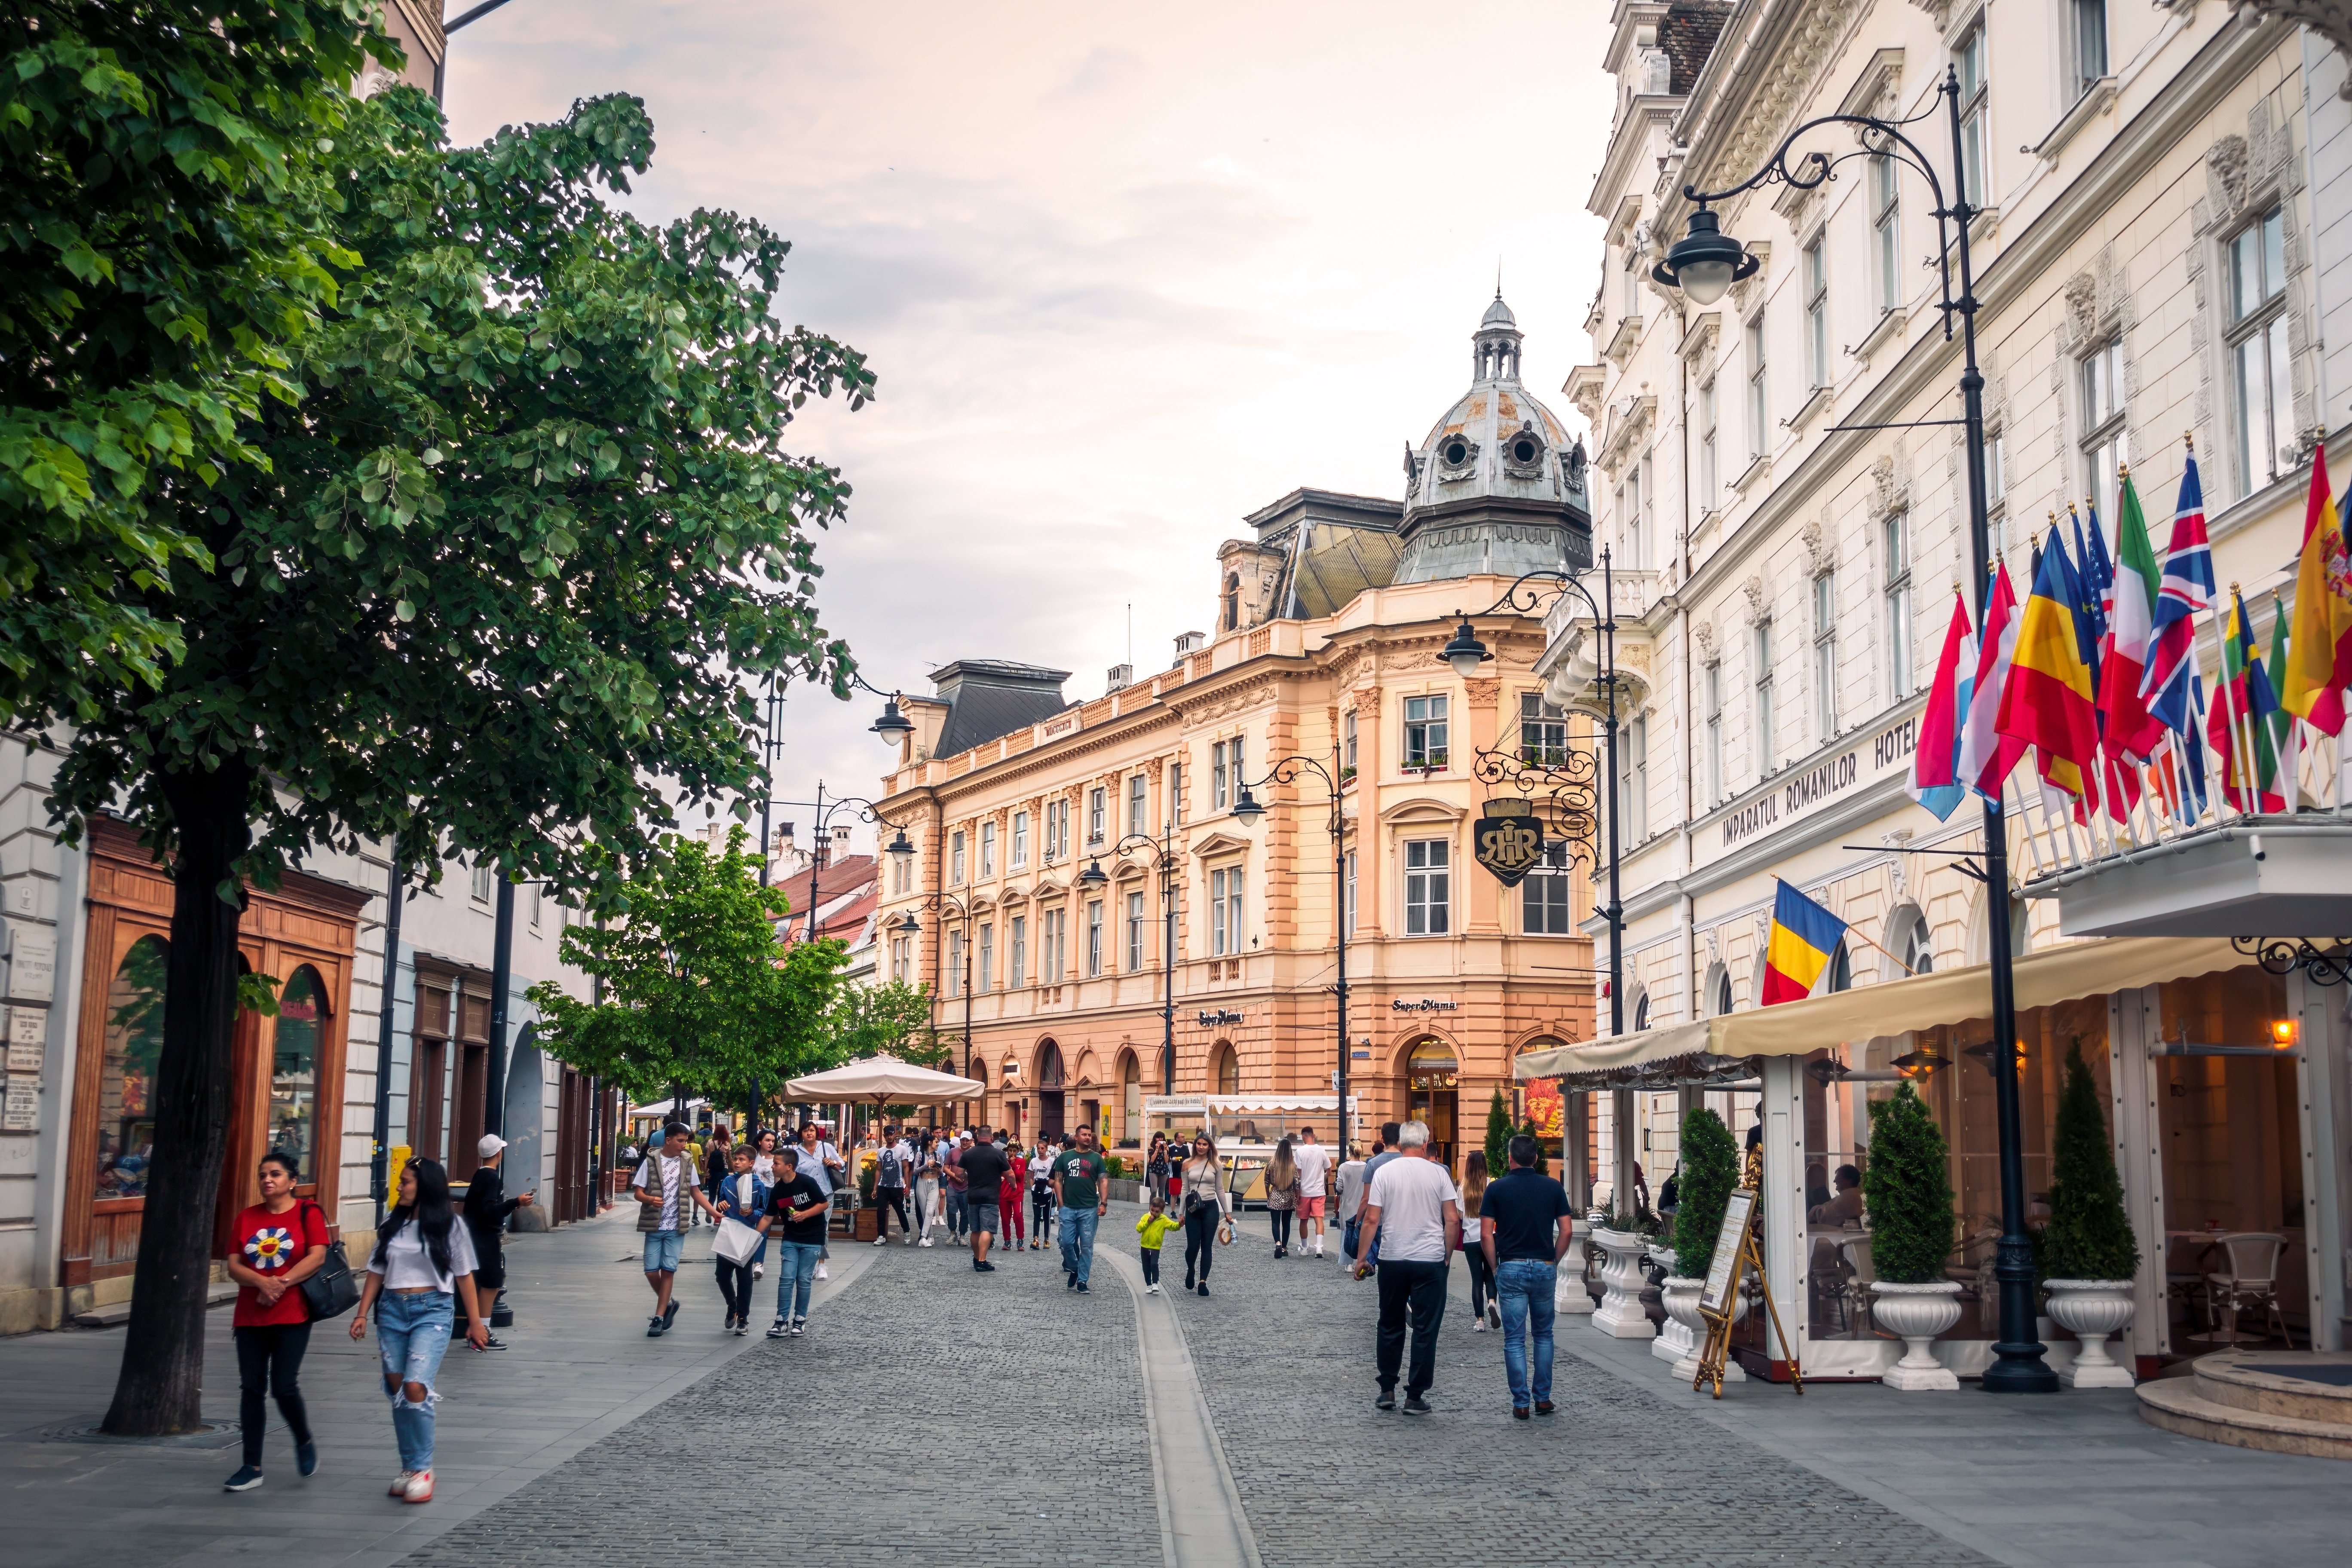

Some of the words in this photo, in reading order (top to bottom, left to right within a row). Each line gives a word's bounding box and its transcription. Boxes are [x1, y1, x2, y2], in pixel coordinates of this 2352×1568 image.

[1723, 793, 1778, 848] IMPARATUL
[1786, 752, 1856, 816] ROMANILOR
[1875, 717, 1918, 770] HOTEL
[1392, 998, 1421, 1013] Super
[1421, 998, 1458, 1012] Mama
